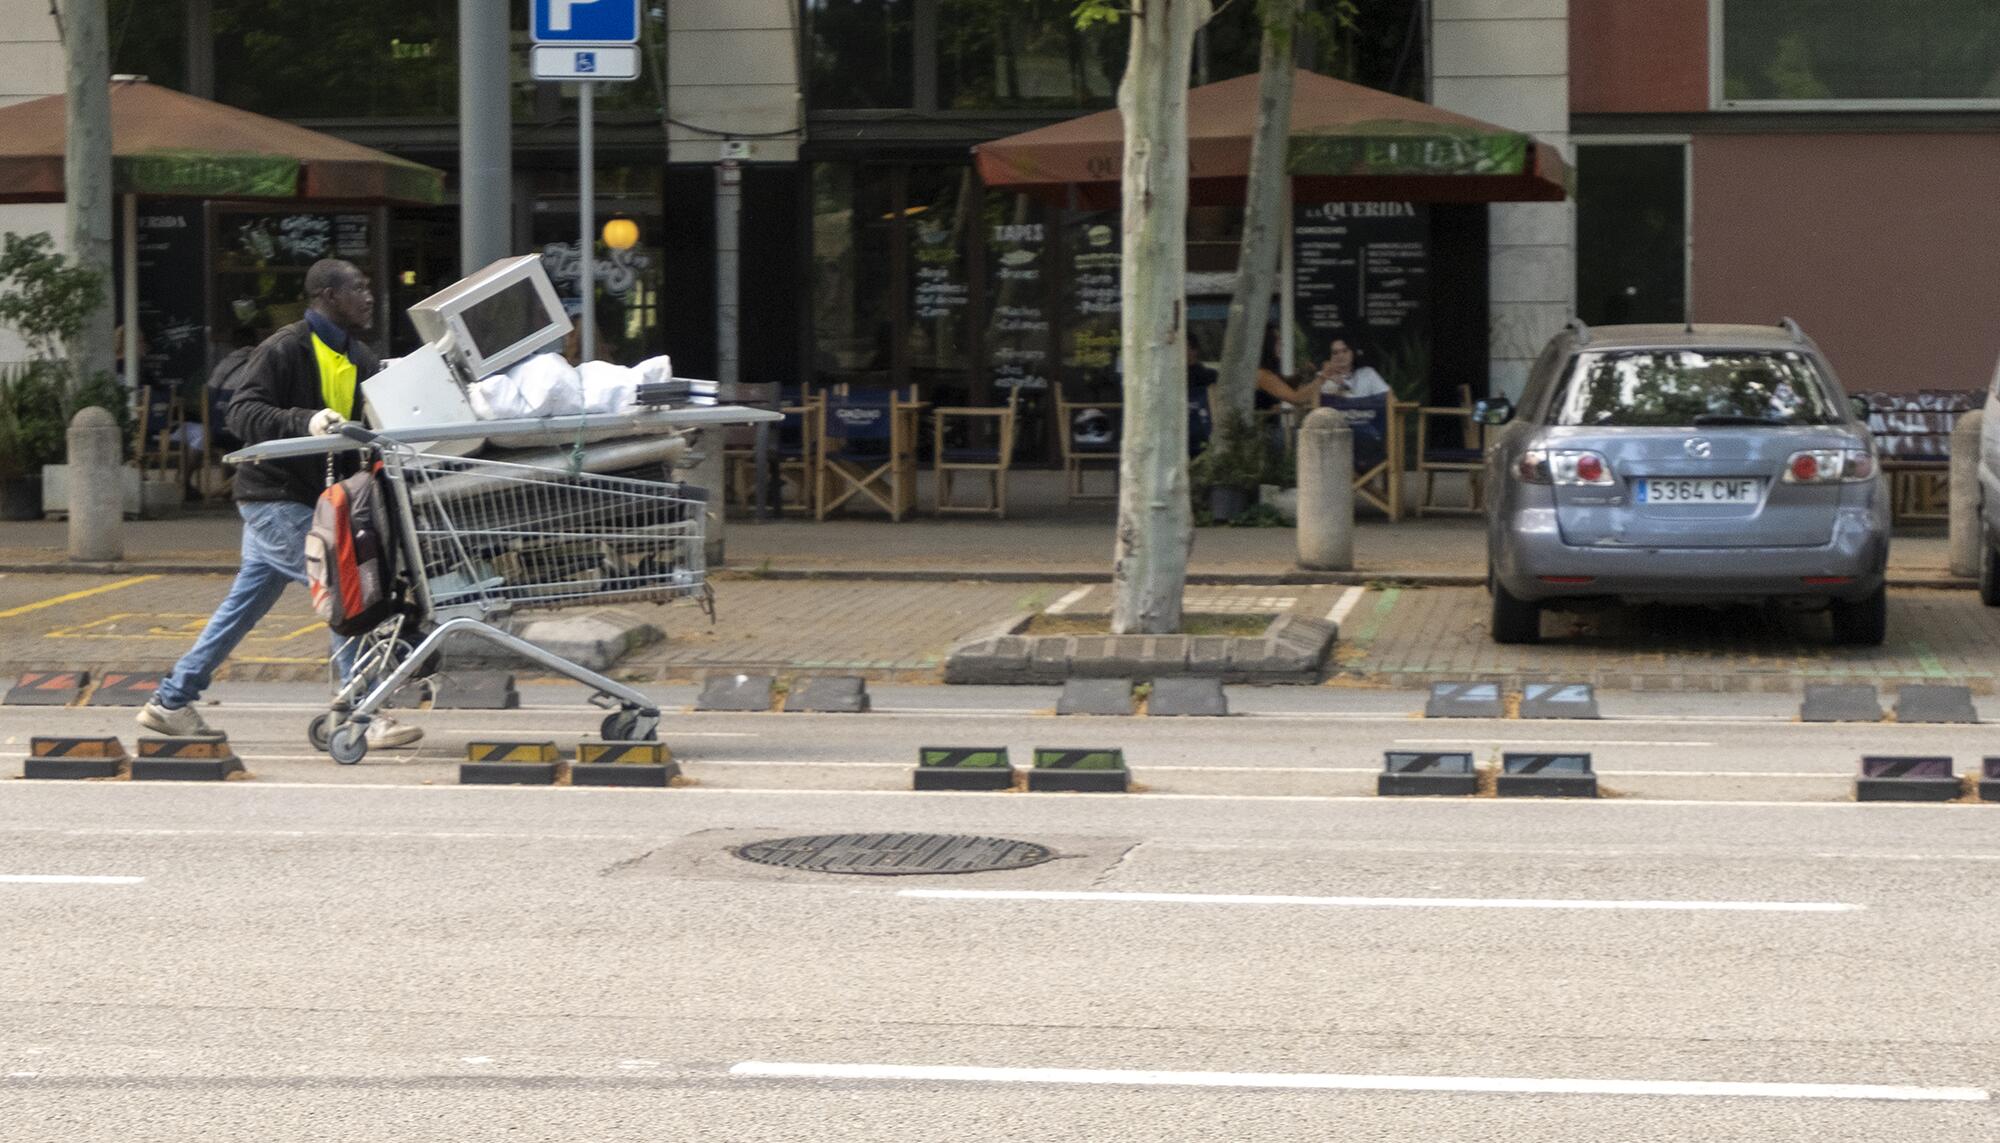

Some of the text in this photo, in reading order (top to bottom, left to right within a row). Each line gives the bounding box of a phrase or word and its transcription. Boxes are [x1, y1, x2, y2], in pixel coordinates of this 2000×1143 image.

[1323, 201, 1415, 220] QUERIDA
[1651, 481, 1751, 499] 5364 CWF
